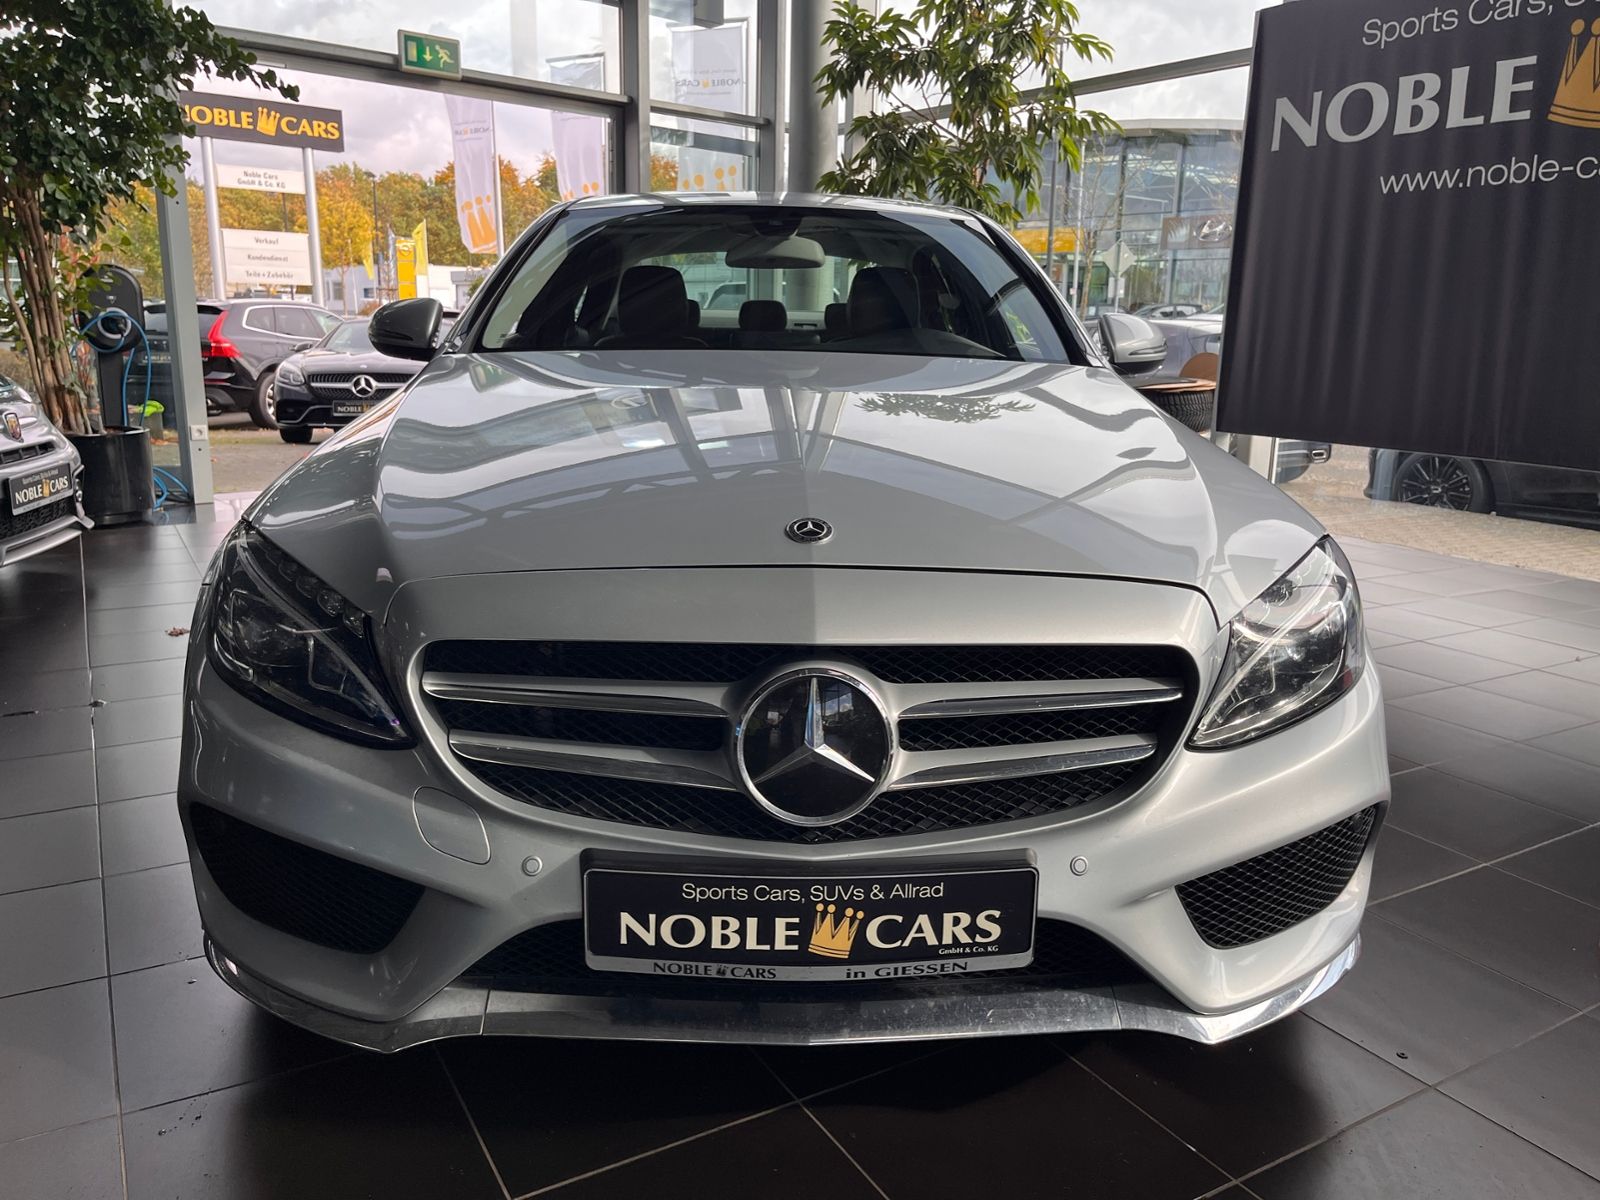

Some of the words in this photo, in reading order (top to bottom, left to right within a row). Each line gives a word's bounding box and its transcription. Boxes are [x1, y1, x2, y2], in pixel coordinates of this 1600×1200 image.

[1362, 7, 1459, 49] Sports
[1271, 55, 1538, 152] NOBLE
[280, 116, 340, 140] CARS
[263, 172, 278, 180] Cars
[1380, 154, 1600, 194] www.noble-c
[254, 237, 279, 245] Verkauf
[15, 484, 43, 505] NOBLE
[50, 476, 69, 493] CARS
[682, 883, 748, 902] Sports
[754, 885, 805, 903] Cars,
[810, 884, 865, 901] SUVs
[870, 884, 885, 899] &
[890, 882, 944, 899] Allrad
[619, 911, 800, 951] NOBLE
[865, 909, 1002, 949] CARS
[653, 962, 713, 976] NOBLE
[731, 966, 777, 979] CARS
[846, 968, 866, 979] in
[874, 961, 968, 977] GIESSEN
